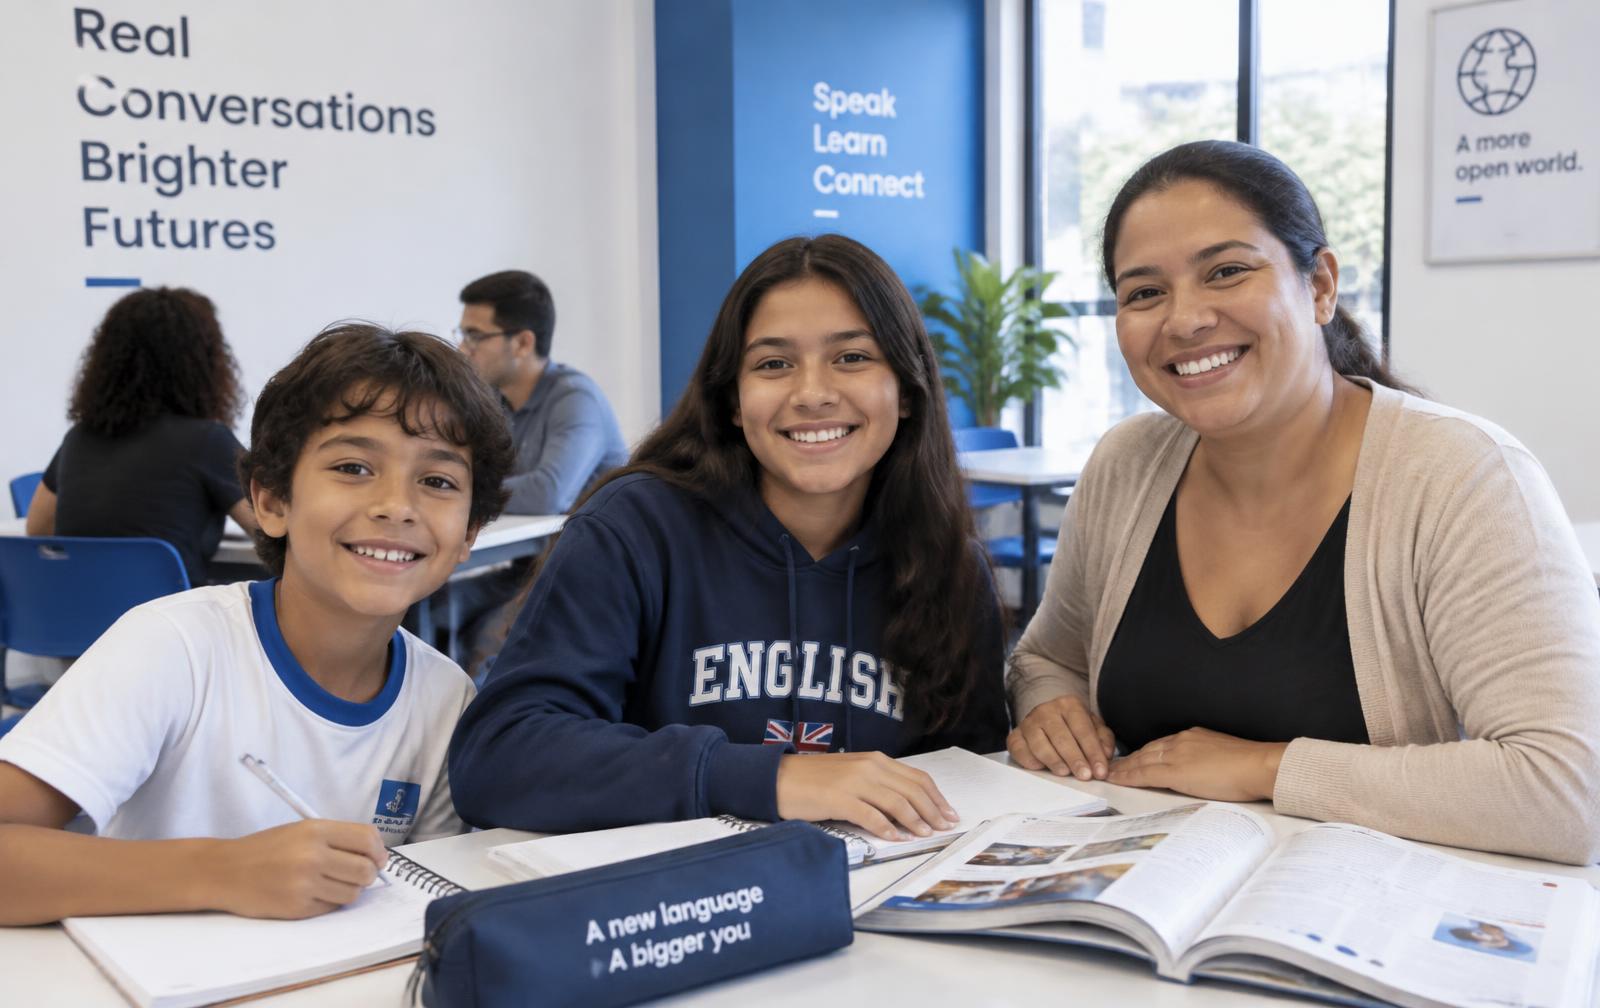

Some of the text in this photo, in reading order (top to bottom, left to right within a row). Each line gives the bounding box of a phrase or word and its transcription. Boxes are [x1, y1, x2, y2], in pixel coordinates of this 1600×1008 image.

[74, 7, 190, 58] Real
[76, 75, 436, 137] Conversations
[813, 81, 897, 120] Speak
[813, 122, 888, 159] Learn
[1456, 131, 1531, 153] A more
[80, 140, 288, 198] Brighter
[813, 164, 926, 199] Connect
[1455, 151, 1583, 183] open world.
[84, 206, 277, 251] Futures
[689, 639, 905, 722] ENGLISH
[586, 886, 764, 946] A new language
[608, 922, 752, 974] A bigger you
